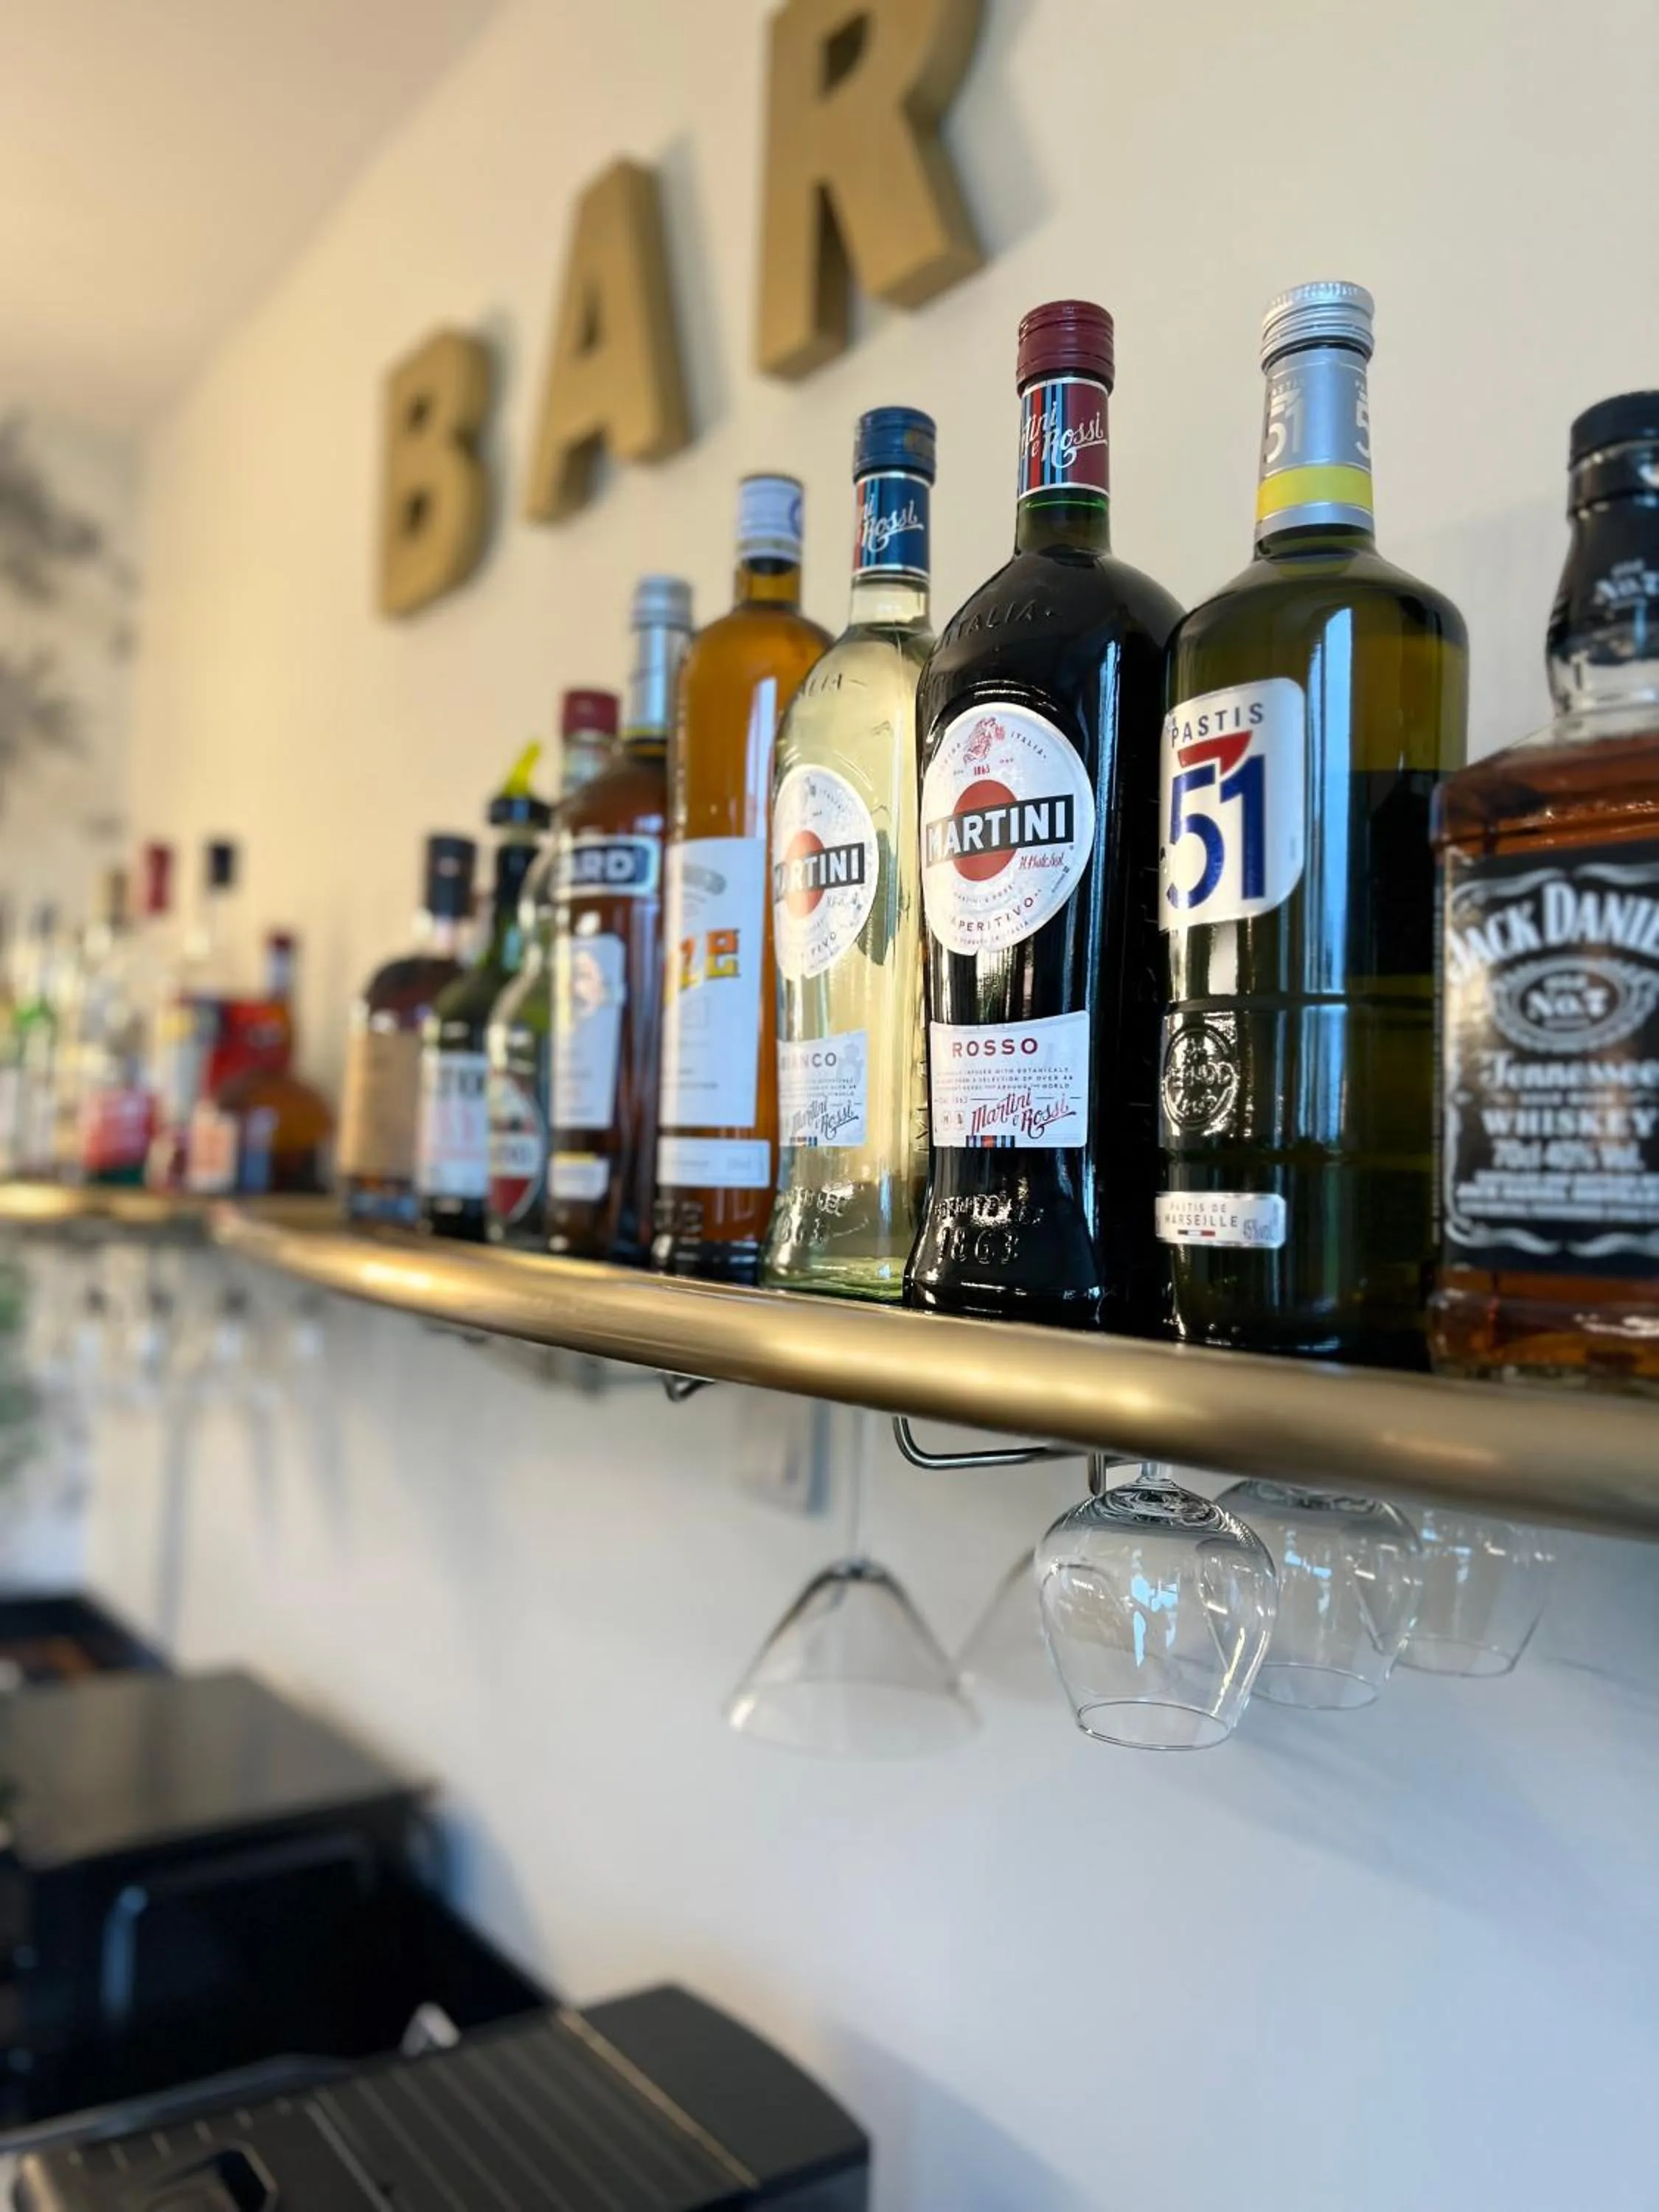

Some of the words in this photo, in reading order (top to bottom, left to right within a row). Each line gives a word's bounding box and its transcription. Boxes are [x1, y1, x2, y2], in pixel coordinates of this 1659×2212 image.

[379, 0, 988, 624] BAR
[1171, 702, 1264, 748] PASTIS
[928, 801, 1066, 862] MARTINI
[1167, 754, 1265, 911] 51
[783, 848, 860, 895] RTINI
[952, 1037, 1038, 1058] ROSSO
[970, 1088, 1032, 1138] Martini
[1021, 1093, 1077, 1139] Rossi
[1164, 1215, 1239, 1228] MARSEILLE
